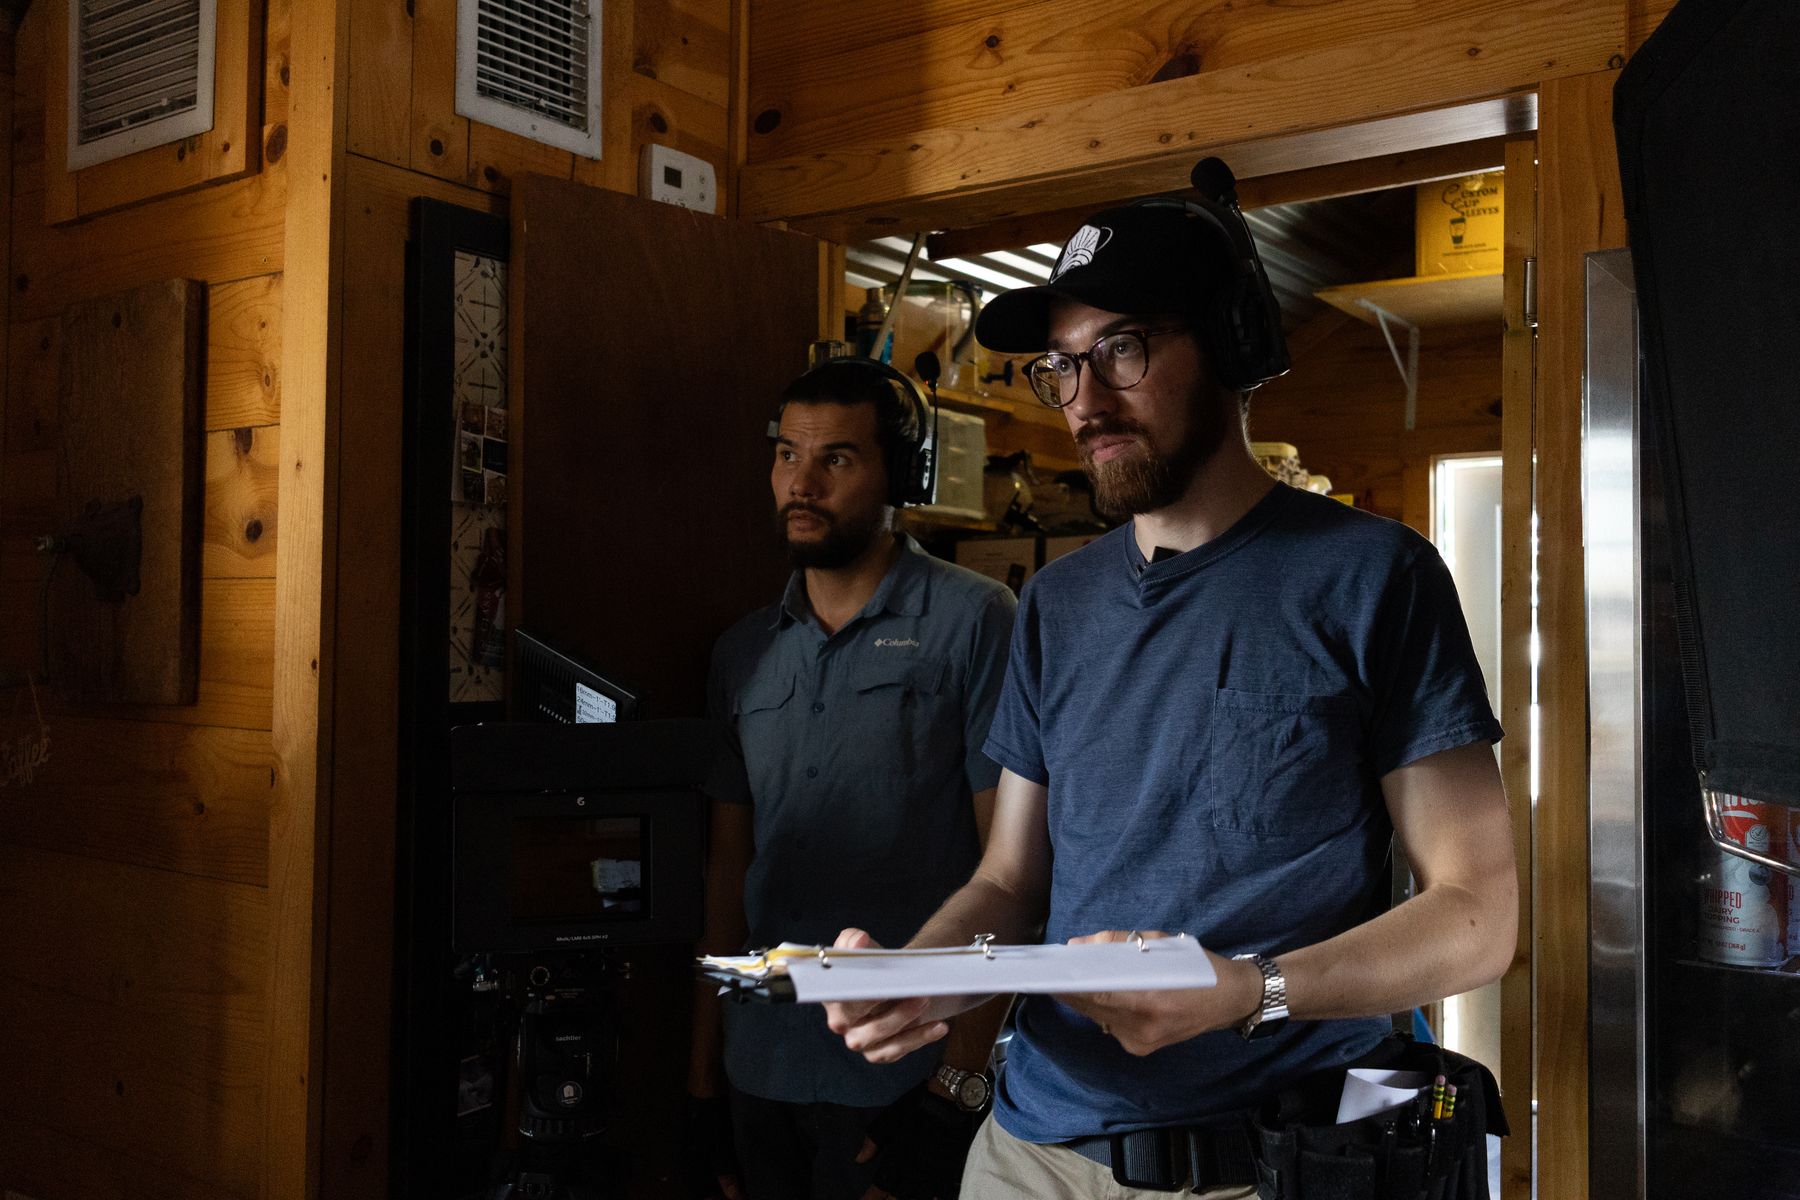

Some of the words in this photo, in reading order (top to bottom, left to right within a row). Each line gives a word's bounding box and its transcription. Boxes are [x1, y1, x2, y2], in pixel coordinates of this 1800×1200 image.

[1460, 206, 1499, 217] SLEEVES
[1703, 887, 1742, 909] WHIPPED
[1708, 905, 1733, 915] DAIRY
[1704, 912, 1740, 924] TOPPING
